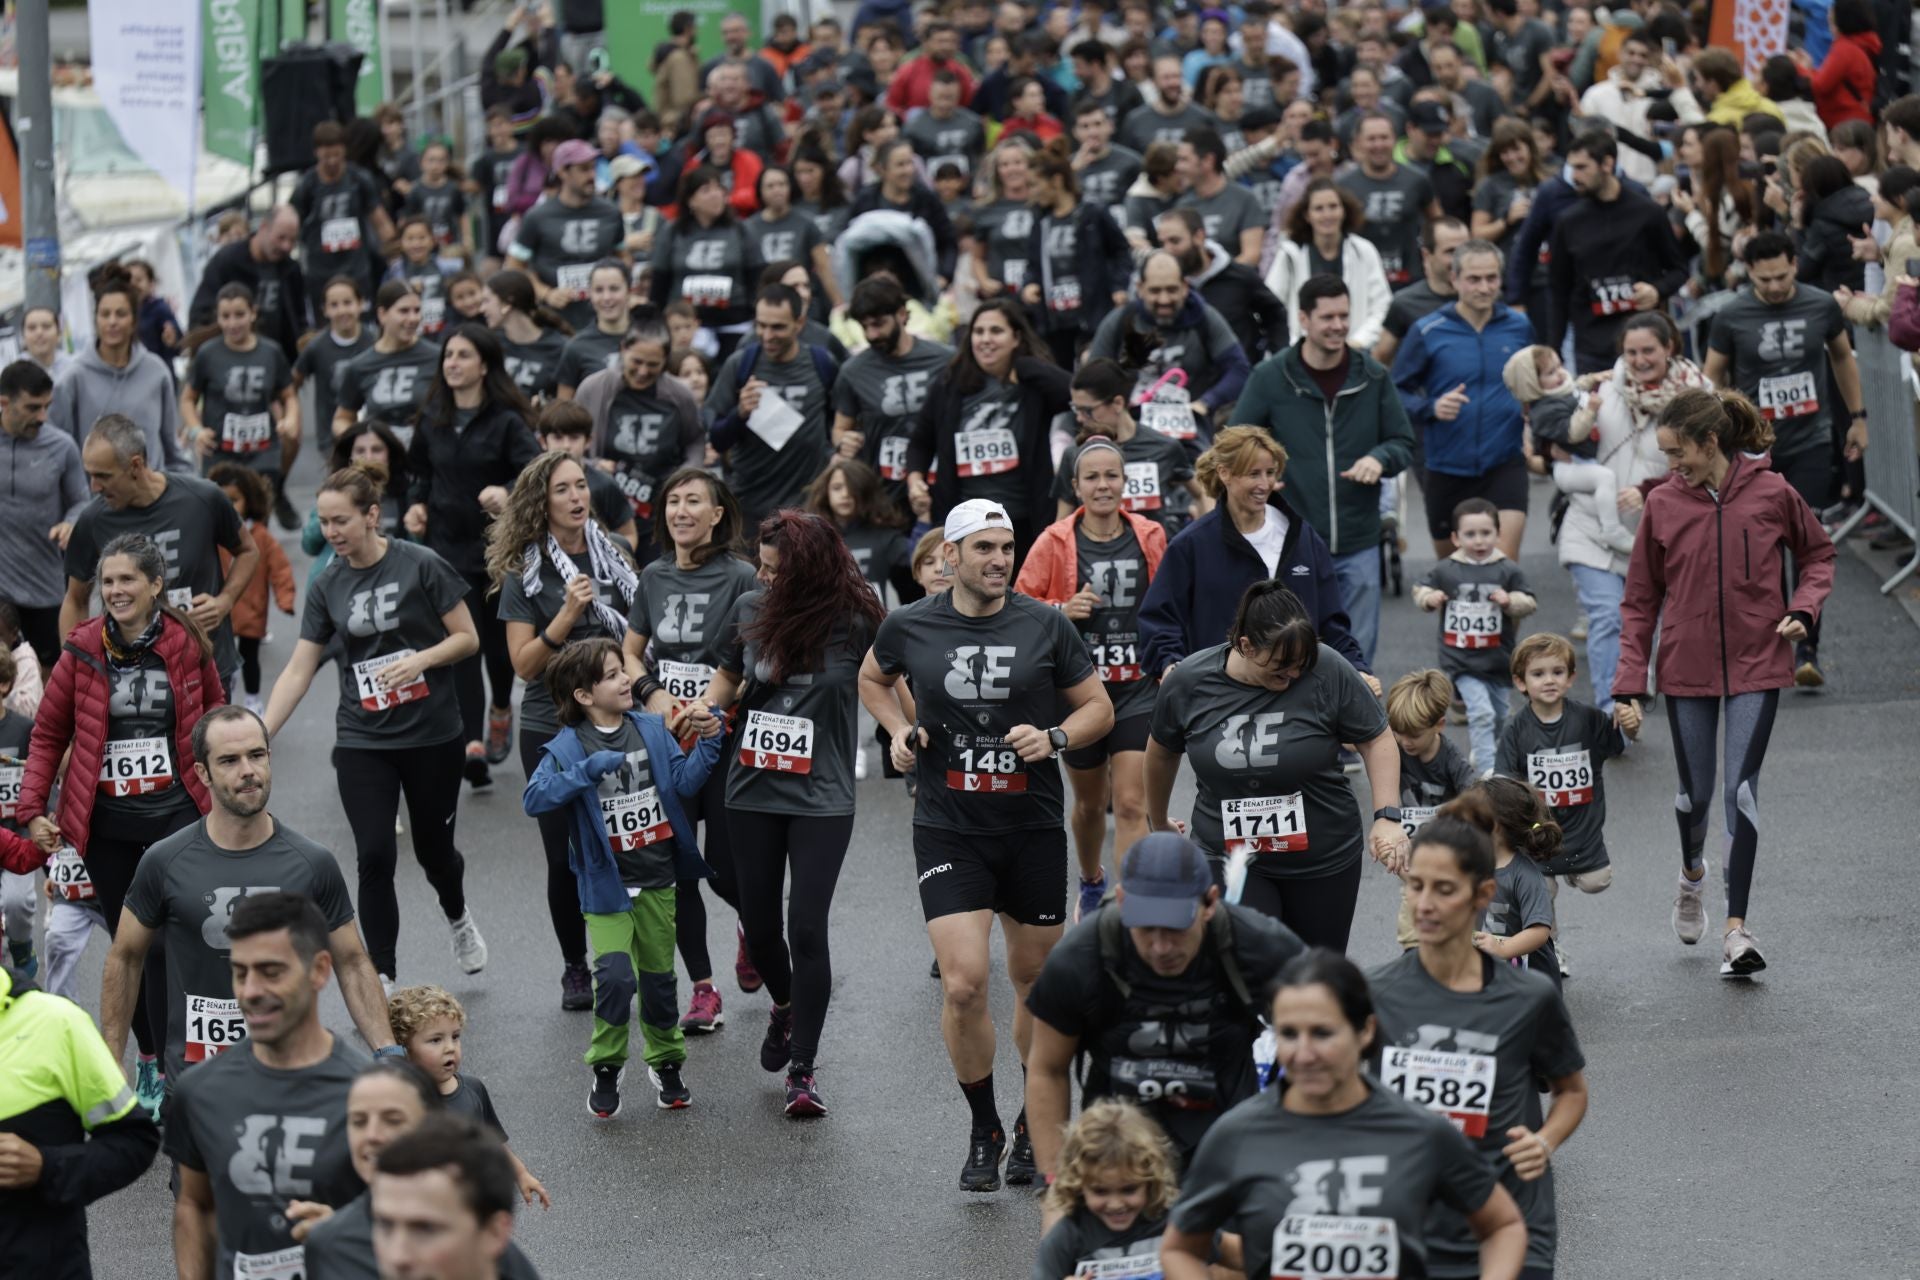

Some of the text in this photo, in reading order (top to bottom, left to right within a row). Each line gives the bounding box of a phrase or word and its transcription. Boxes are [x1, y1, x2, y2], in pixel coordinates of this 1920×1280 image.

[1764, 384, 1811, 406] 1901
[962, 442, 1013, 460] 1898
[1127, 478, 1155, 495] 85
[1449, 616, 1498, 632] 2043
[1093, 644, 1136, 665] 131
[749, 728, 808, 754] 1694
[102, 754, 167, 778] 1612
[959, 749, 1016, 773] 148
[1534, 767, 1589, 789] 2039
[605, 801, 661, 834] 1691
[1229, 810, 1298, 837] 1711
[54, 863, 87, 883] 192
[192, 1017, 246, 1042] 165
[1390, 1073, 1486, 1109] 1582
[1282, 1243, 1388, 1274] 2003
